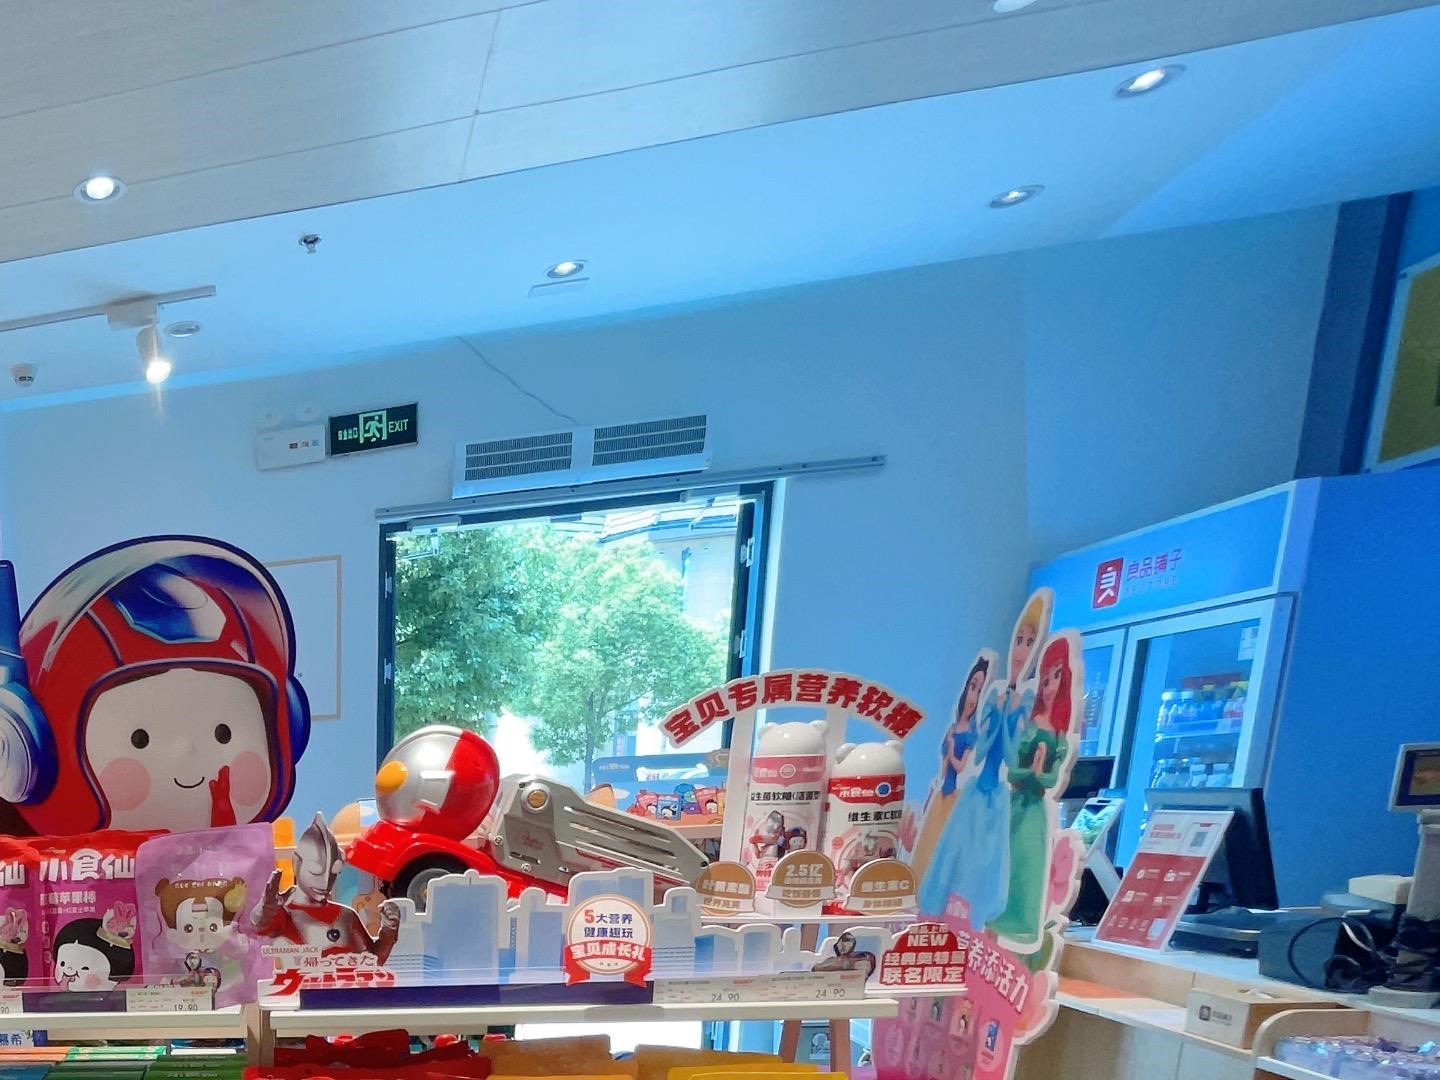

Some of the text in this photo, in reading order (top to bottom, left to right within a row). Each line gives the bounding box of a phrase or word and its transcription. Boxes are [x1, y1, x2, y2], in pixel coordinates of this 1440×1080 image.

[388, 419, 409, 433] EXIT
[1127, 548, 1182, 581] 良品铺子
[663, 674, 924, 744] 宝贝专属营养软糖
[39, 848, 135, 882] 小食仙
[584, 909, 633, 924] 5大营养
[584, 927, 633, 938] 健康趣玩
[907, 934, 948, 946] NEW
[570, 942, 645, 961] 宝贝成长礼
[882, 966, 965, 984] 联名限定
